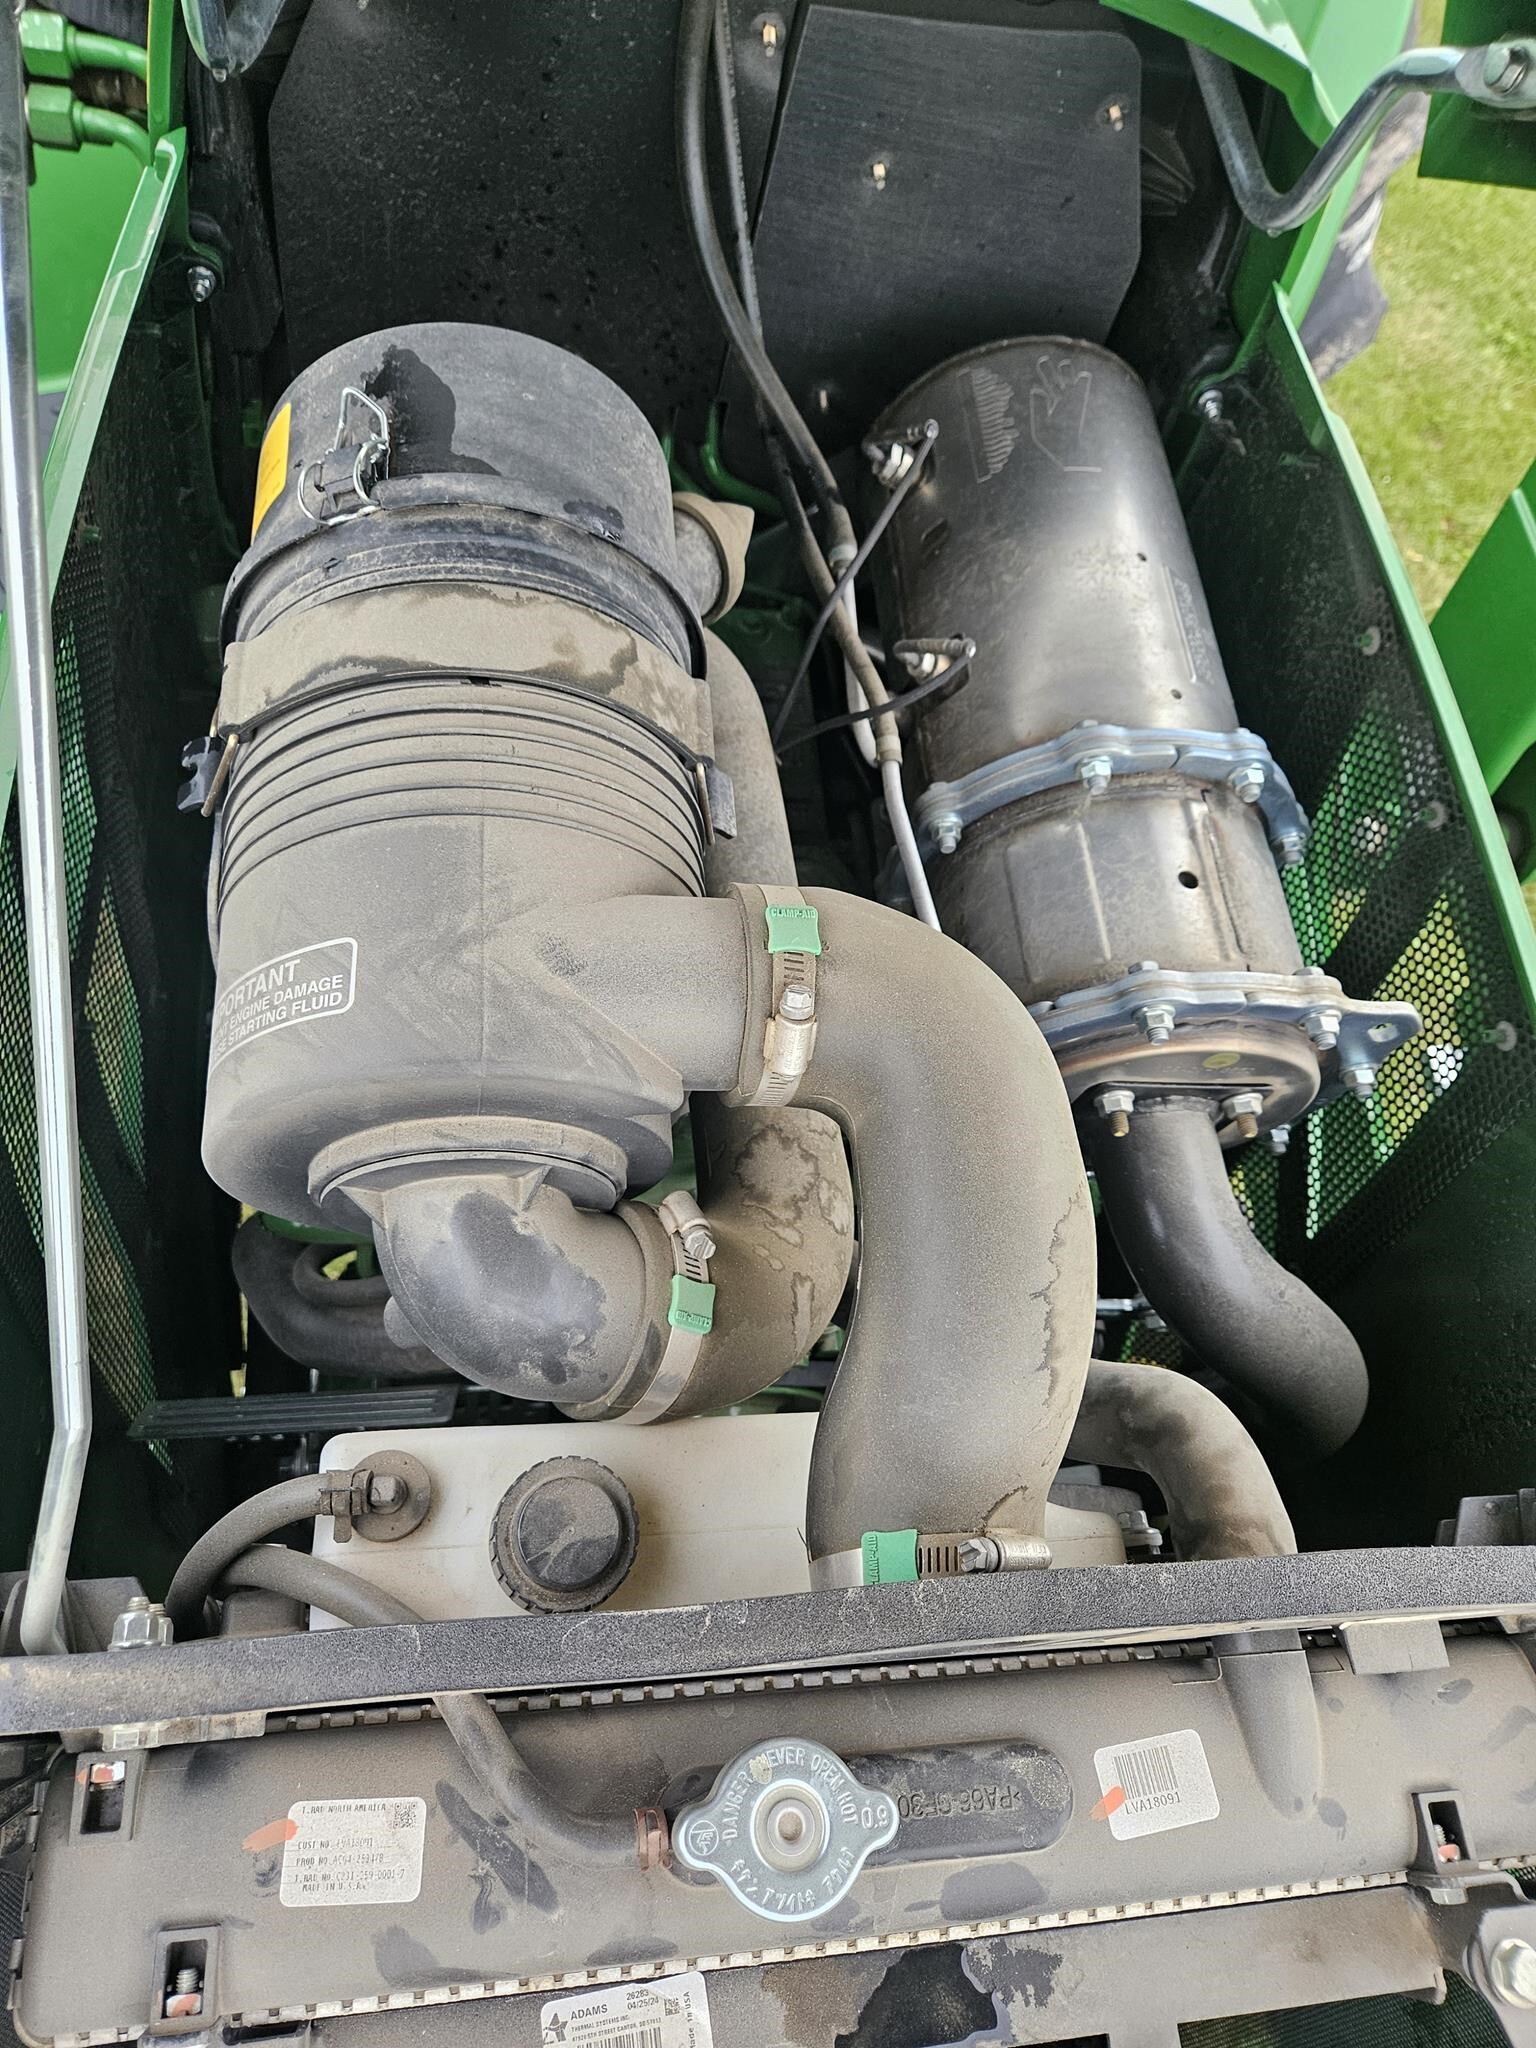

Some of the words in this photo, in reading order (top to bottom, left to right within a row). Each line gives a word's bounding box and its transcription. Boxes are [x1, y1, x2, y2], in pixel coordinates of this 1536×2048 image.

[770, 908, 816, 919] CLAMP-AID
[214, 959, 300, 1017] PORTANT
[230, 996, 271, 1029] ENGINE
[274, 974, 343, 1006] DAMAGE
[228, 1007, 287, 1046] STARTING
[291, 991, 343, 1016] FLUID
[838, 1791, 859, 1824] HOT
[1124, 1790, 1182, 1815] LVA18091
[626, 1988, 649, 2001] 26283
[627, 1996, 660, 2011] 04/25/24
[682, 1991, 692, 2011] USA
[570, 2003, 608, 2021] ADAMS
